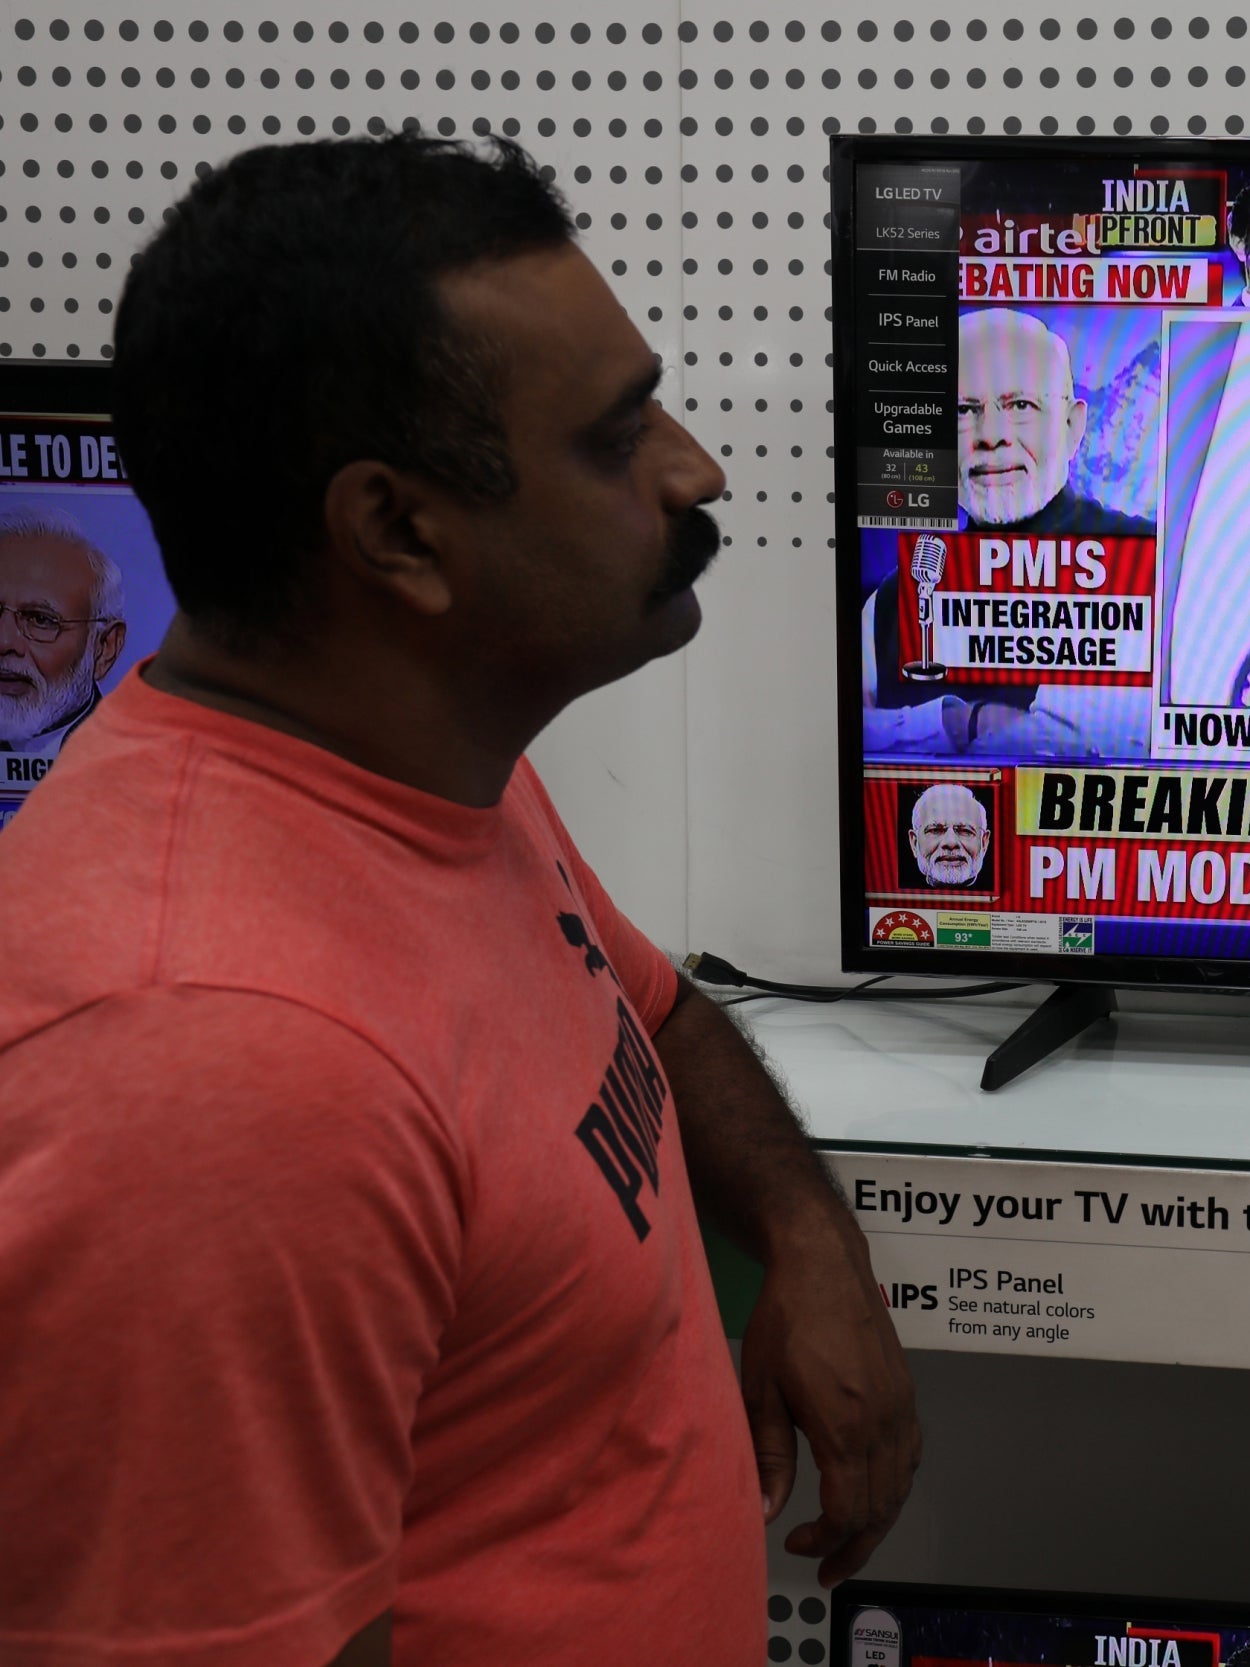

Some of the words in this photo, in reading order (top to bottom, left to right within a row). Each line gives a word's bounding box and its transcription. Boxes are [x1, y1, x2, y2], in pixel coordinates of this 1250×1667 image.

[923, 188, 942, 200] TV
[1102, 179, 1190, 213] INDIA
[876, 227, 905, 238] LK52
[907, 228, 940, 239] Series
[974, 219, 1101, 254] airtel
[879, 269, 898, 281] FM
[902, 270, 936, 282] Radio
[1107, 264, 1191, 298] NOW
[879, 313, 902, 327] IPS
[906, 316, 939, 328] Panel
[868, 360, 902, 373] Quick
[906, 361, 947, 373] Access
[874, 402, 943, 417] Upgradable
[883, 420, 932, 435] Games
[34, 434, 71, 478] TO
[883, 449, 923, 459] Available
[926, 450, 934, 459] in
[886, 464, 896, 472] 32
[916, 464, 928, 473] 43
[908, 493, 930, 507] LG
[979, 538, 1107, 589] PM'S
[941, 599, 1144, 631] INTEGRATION
[968, 635, 1116, 666] MESSAGE
[1030, 846, 1116, 900] PM
[854, 1179, 961, 1225] Enjoy
[972, 1193, 1063, 1227] your
[1074, 1190, 1128, 1224] TV
[1141, 1196, 1229, 1230] with
[948, 1267, 988, 1290] IPS
[997, 1271, 1063, 1295] Panel
[891, 1283, 938, 1310] IPS
[948, 1296, 979, 1313] See
[983, 1299, 1041, 1317] natural
[1046, 1302, 1095, 1320] colors
[948, 1318, 987, 1335] from
[993, 1323, 1021, 1342] any
[1026, 1322, 1069, 1343] angle
[865, 1629, 898, 1640] SANSUI
[866, 1650, 886, 1660] LED
[1094, 1635, 1181, 1667] INDIA
